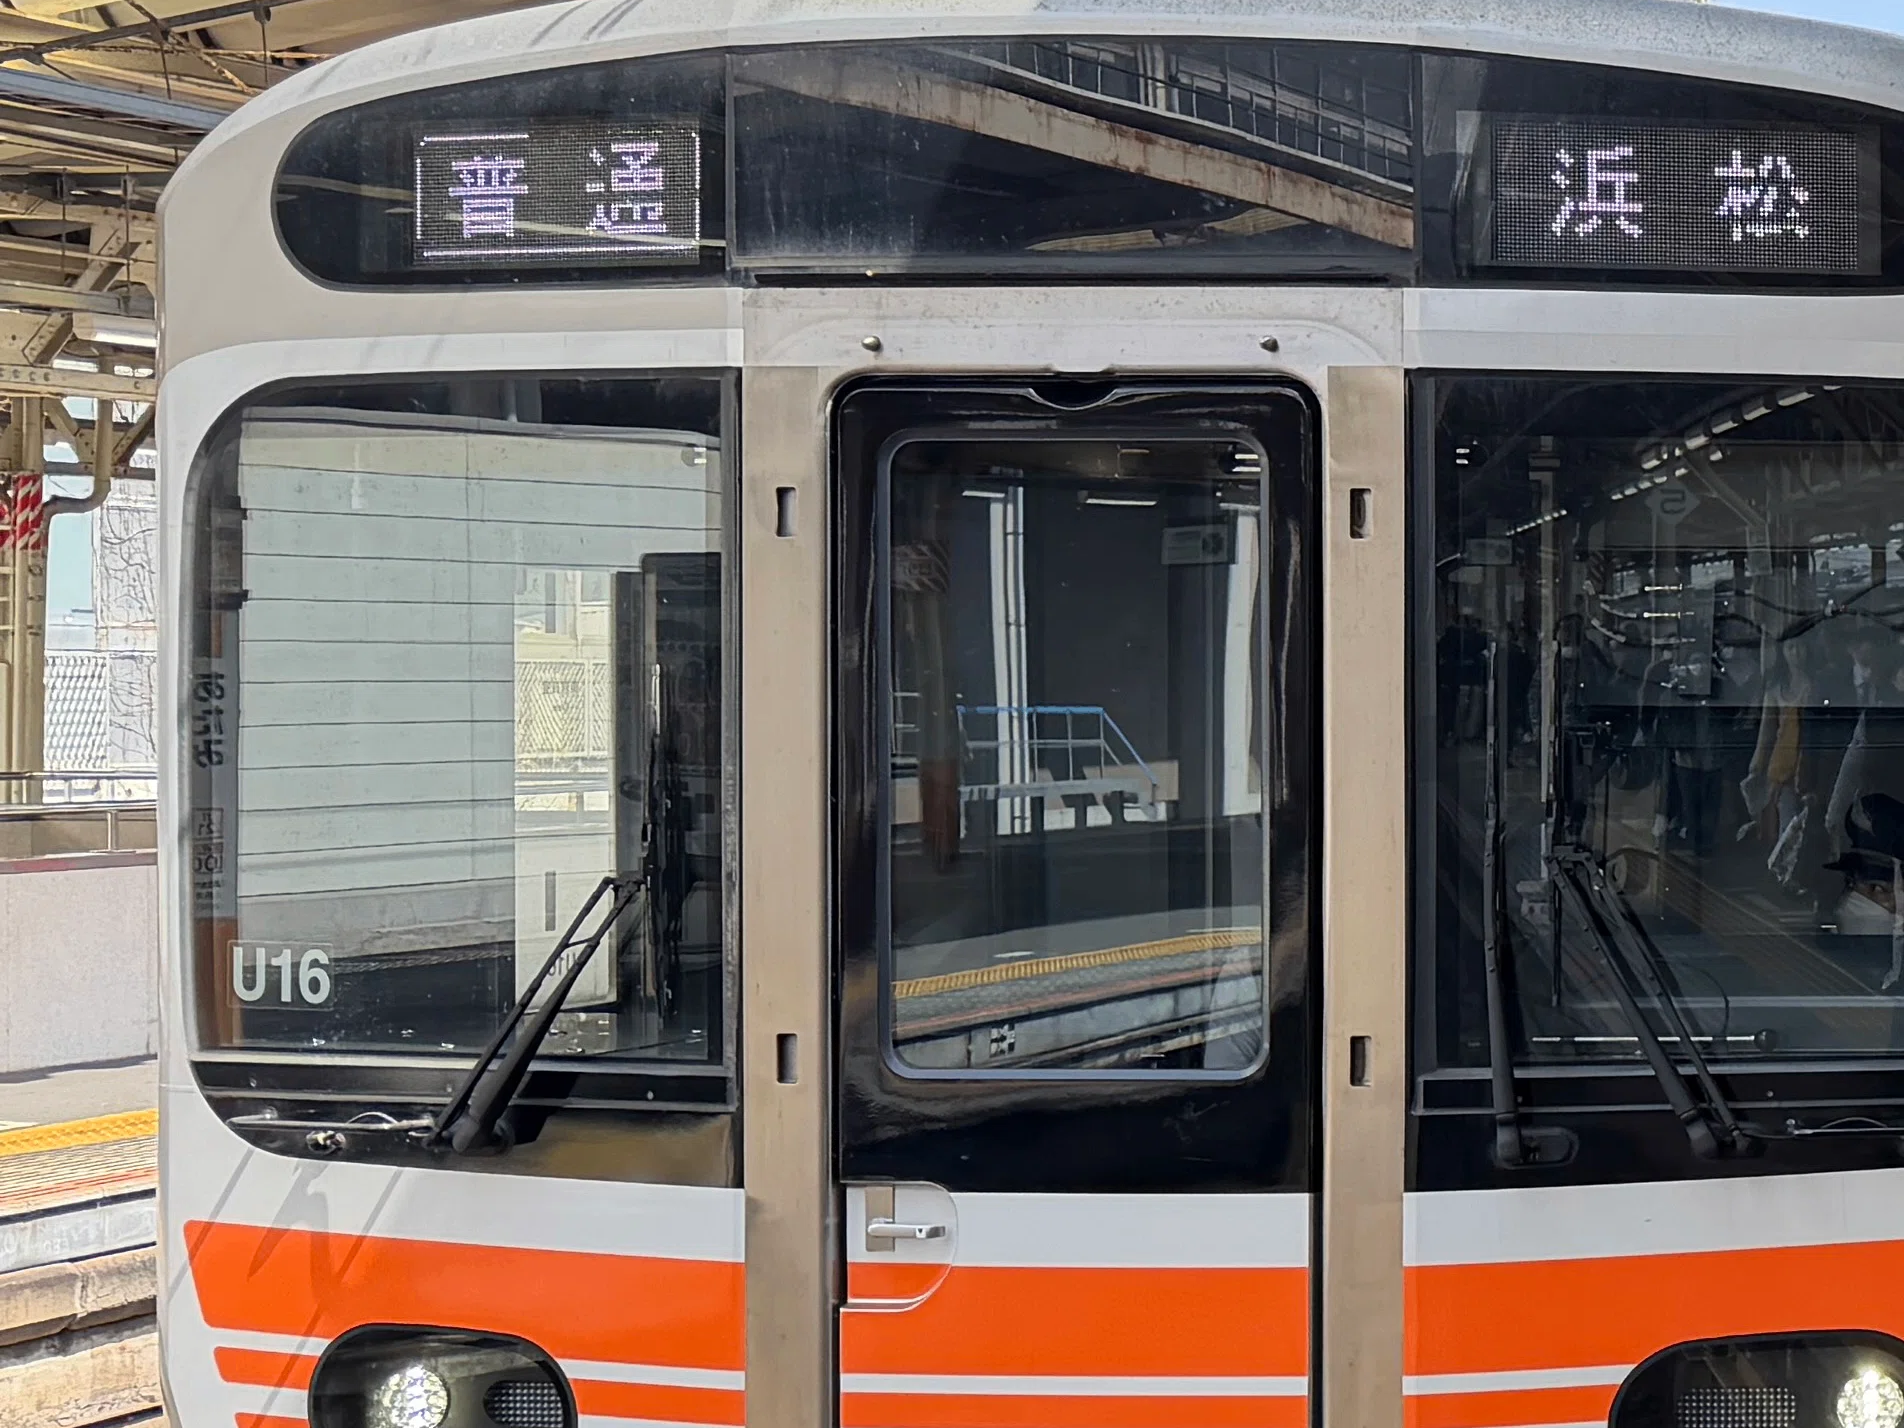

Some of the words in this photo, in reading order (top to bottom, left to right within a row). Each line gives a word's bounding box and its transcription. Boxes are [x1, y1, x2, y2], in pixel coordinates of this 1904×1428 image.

[449, 143, 667, 239] 普通
[1550, 146, 1810, 242] 浜松
[232, 947, 332, 1005] U16
